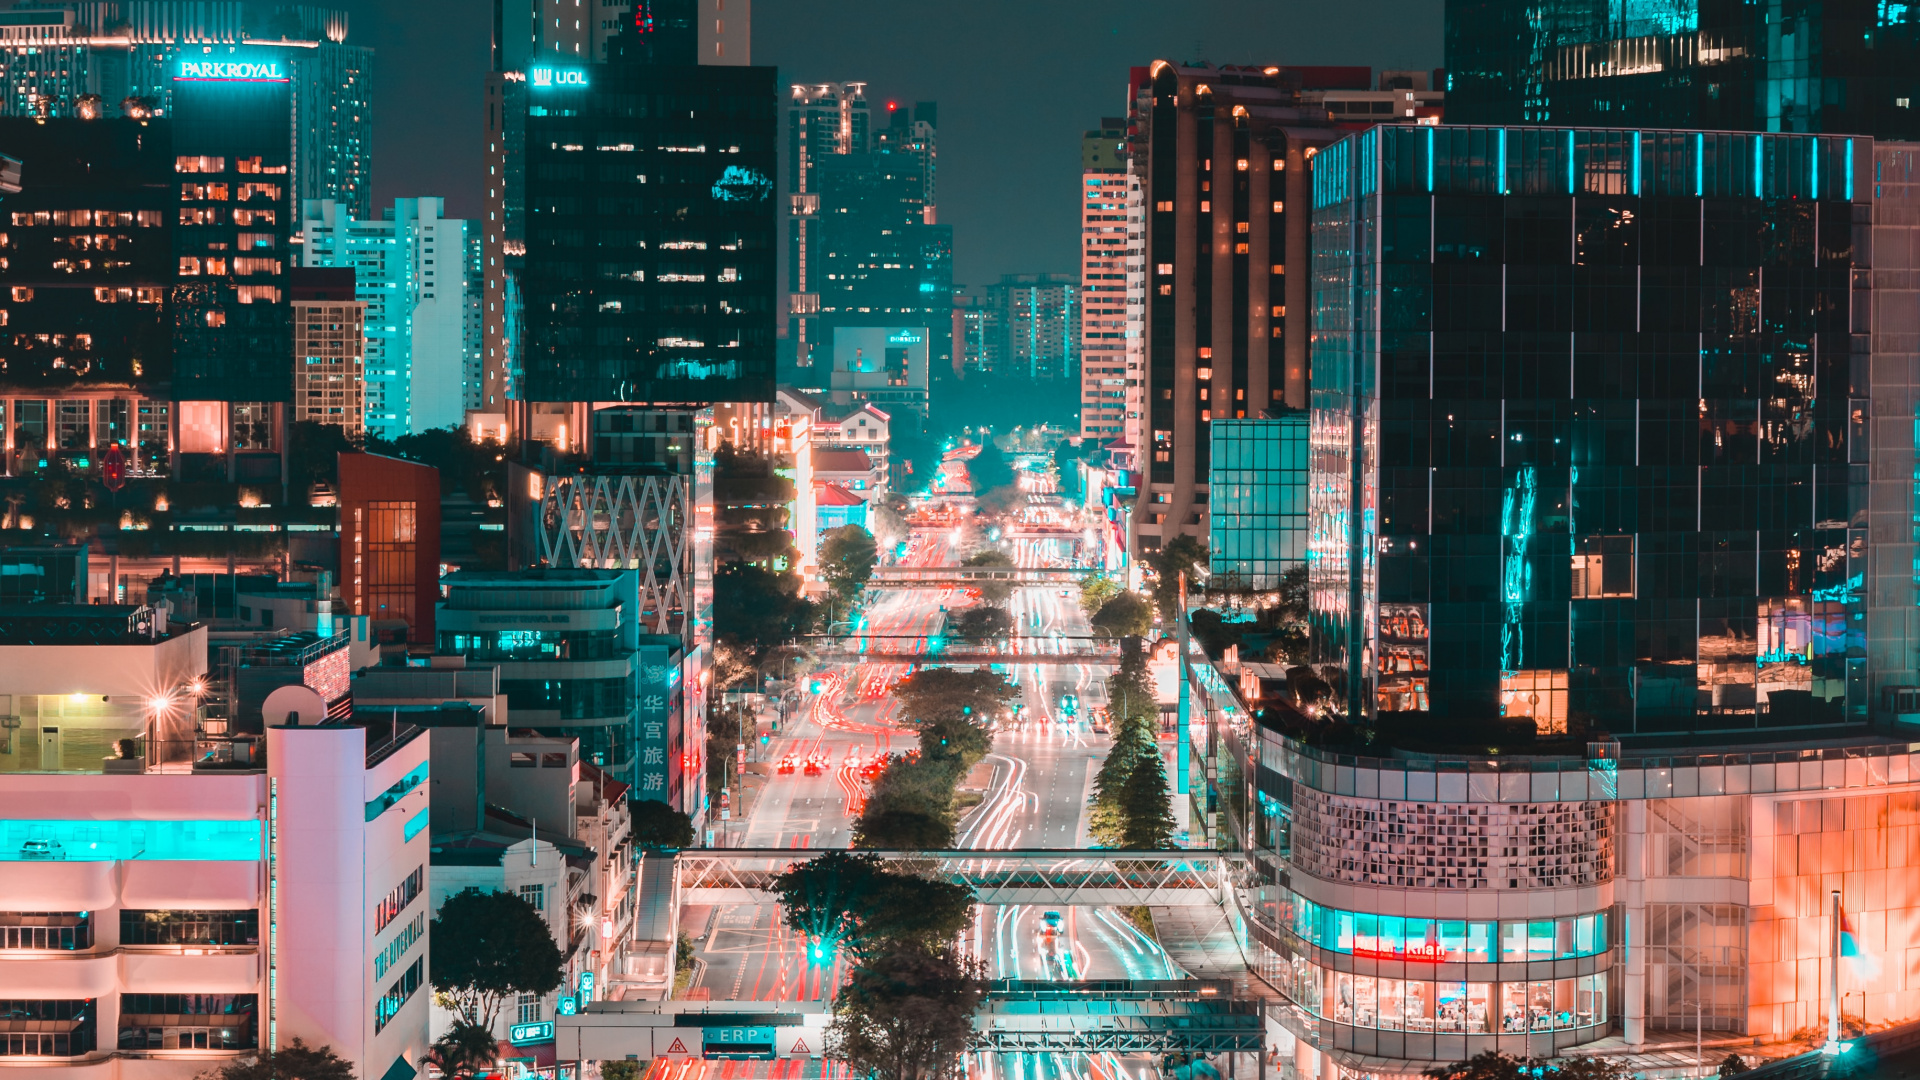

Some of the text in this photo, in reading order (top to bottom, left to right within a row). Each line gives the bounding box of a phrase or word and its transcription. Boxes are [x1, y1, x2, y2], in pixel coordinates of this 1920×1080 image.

[181, 62, 282, 78] PARKROYAL
[556, 71, 587, 84] UOL
[643, 694, 664, 791] 华宫旅游
[374, 911, 425, 983] THE RIVERWALK
[720, 1029, 758, 1042] ERP
[674, 1043, 681, 1051] R
[797, 1043, 804, 1051] R
